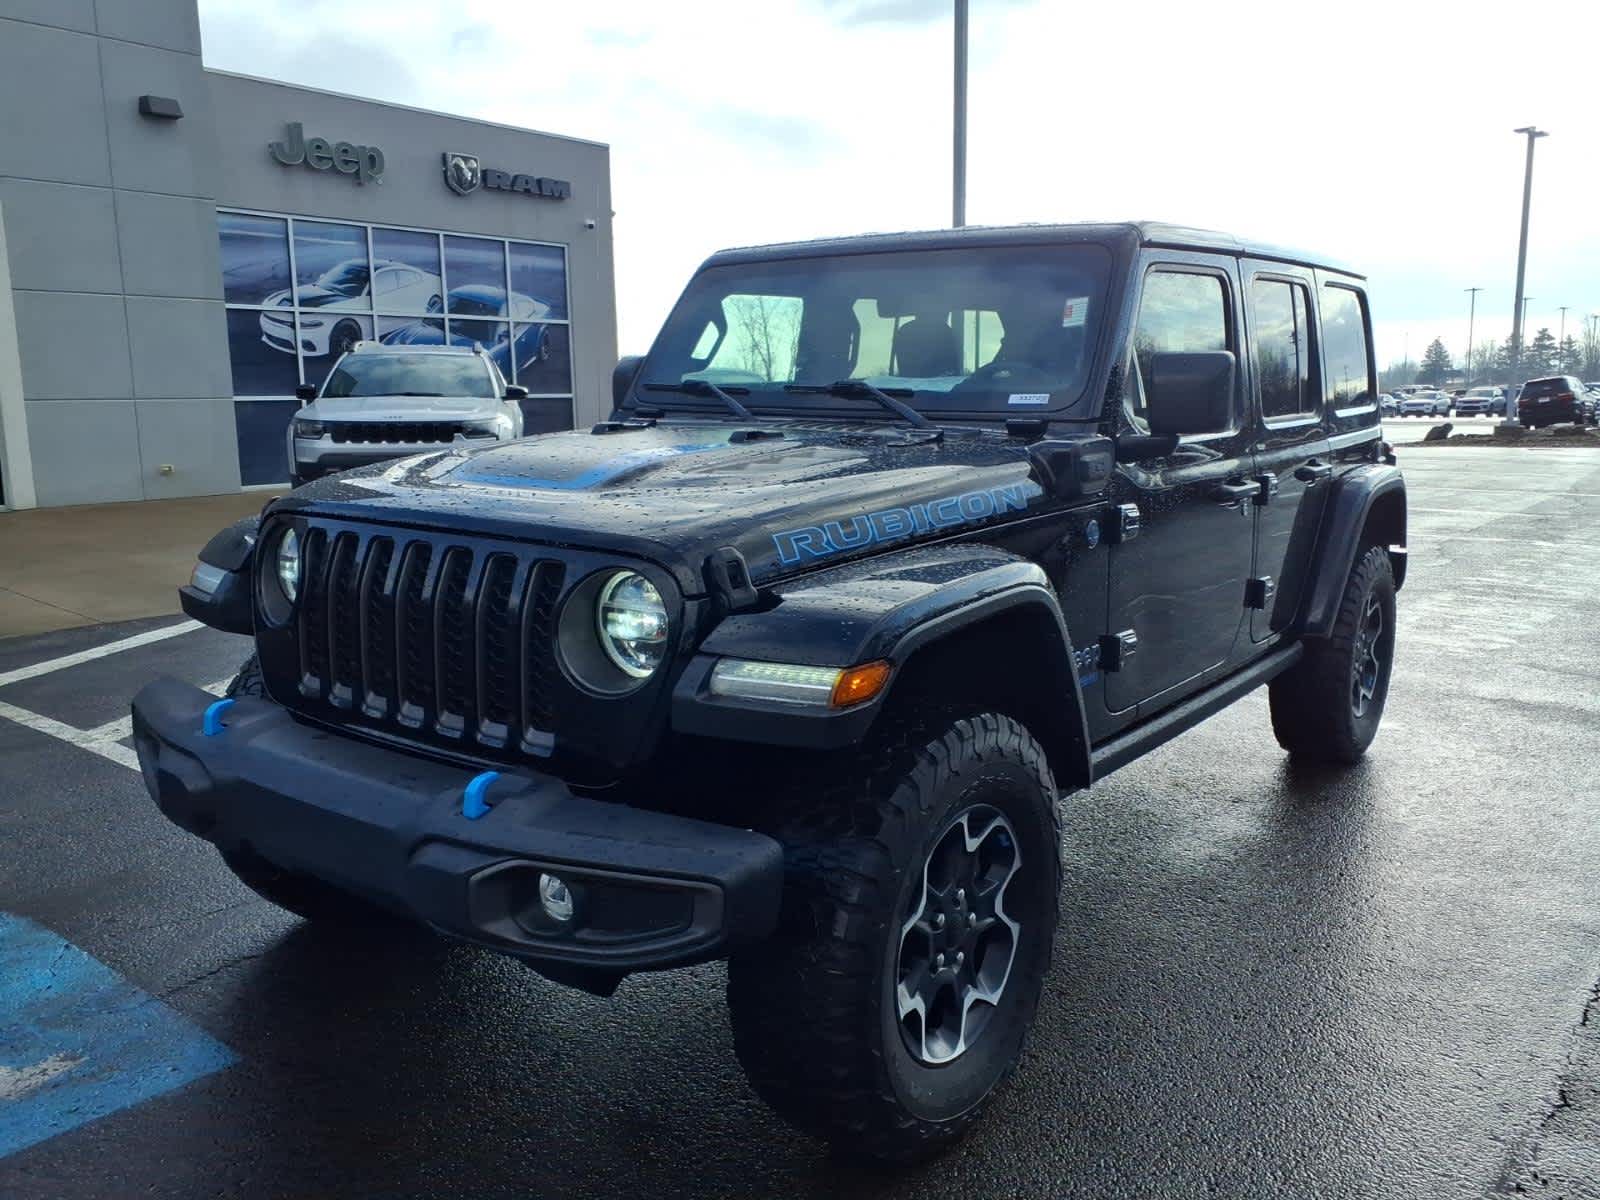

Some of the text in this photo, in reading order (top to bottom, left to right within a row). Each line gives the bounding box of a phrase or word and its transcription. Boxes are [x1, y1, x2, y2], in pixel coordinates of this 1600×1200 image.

[269, 122, 385, 185] Jeep
[482, 168, 571, 200] RAM
[772, 484, 1030, 563] RUBICON
